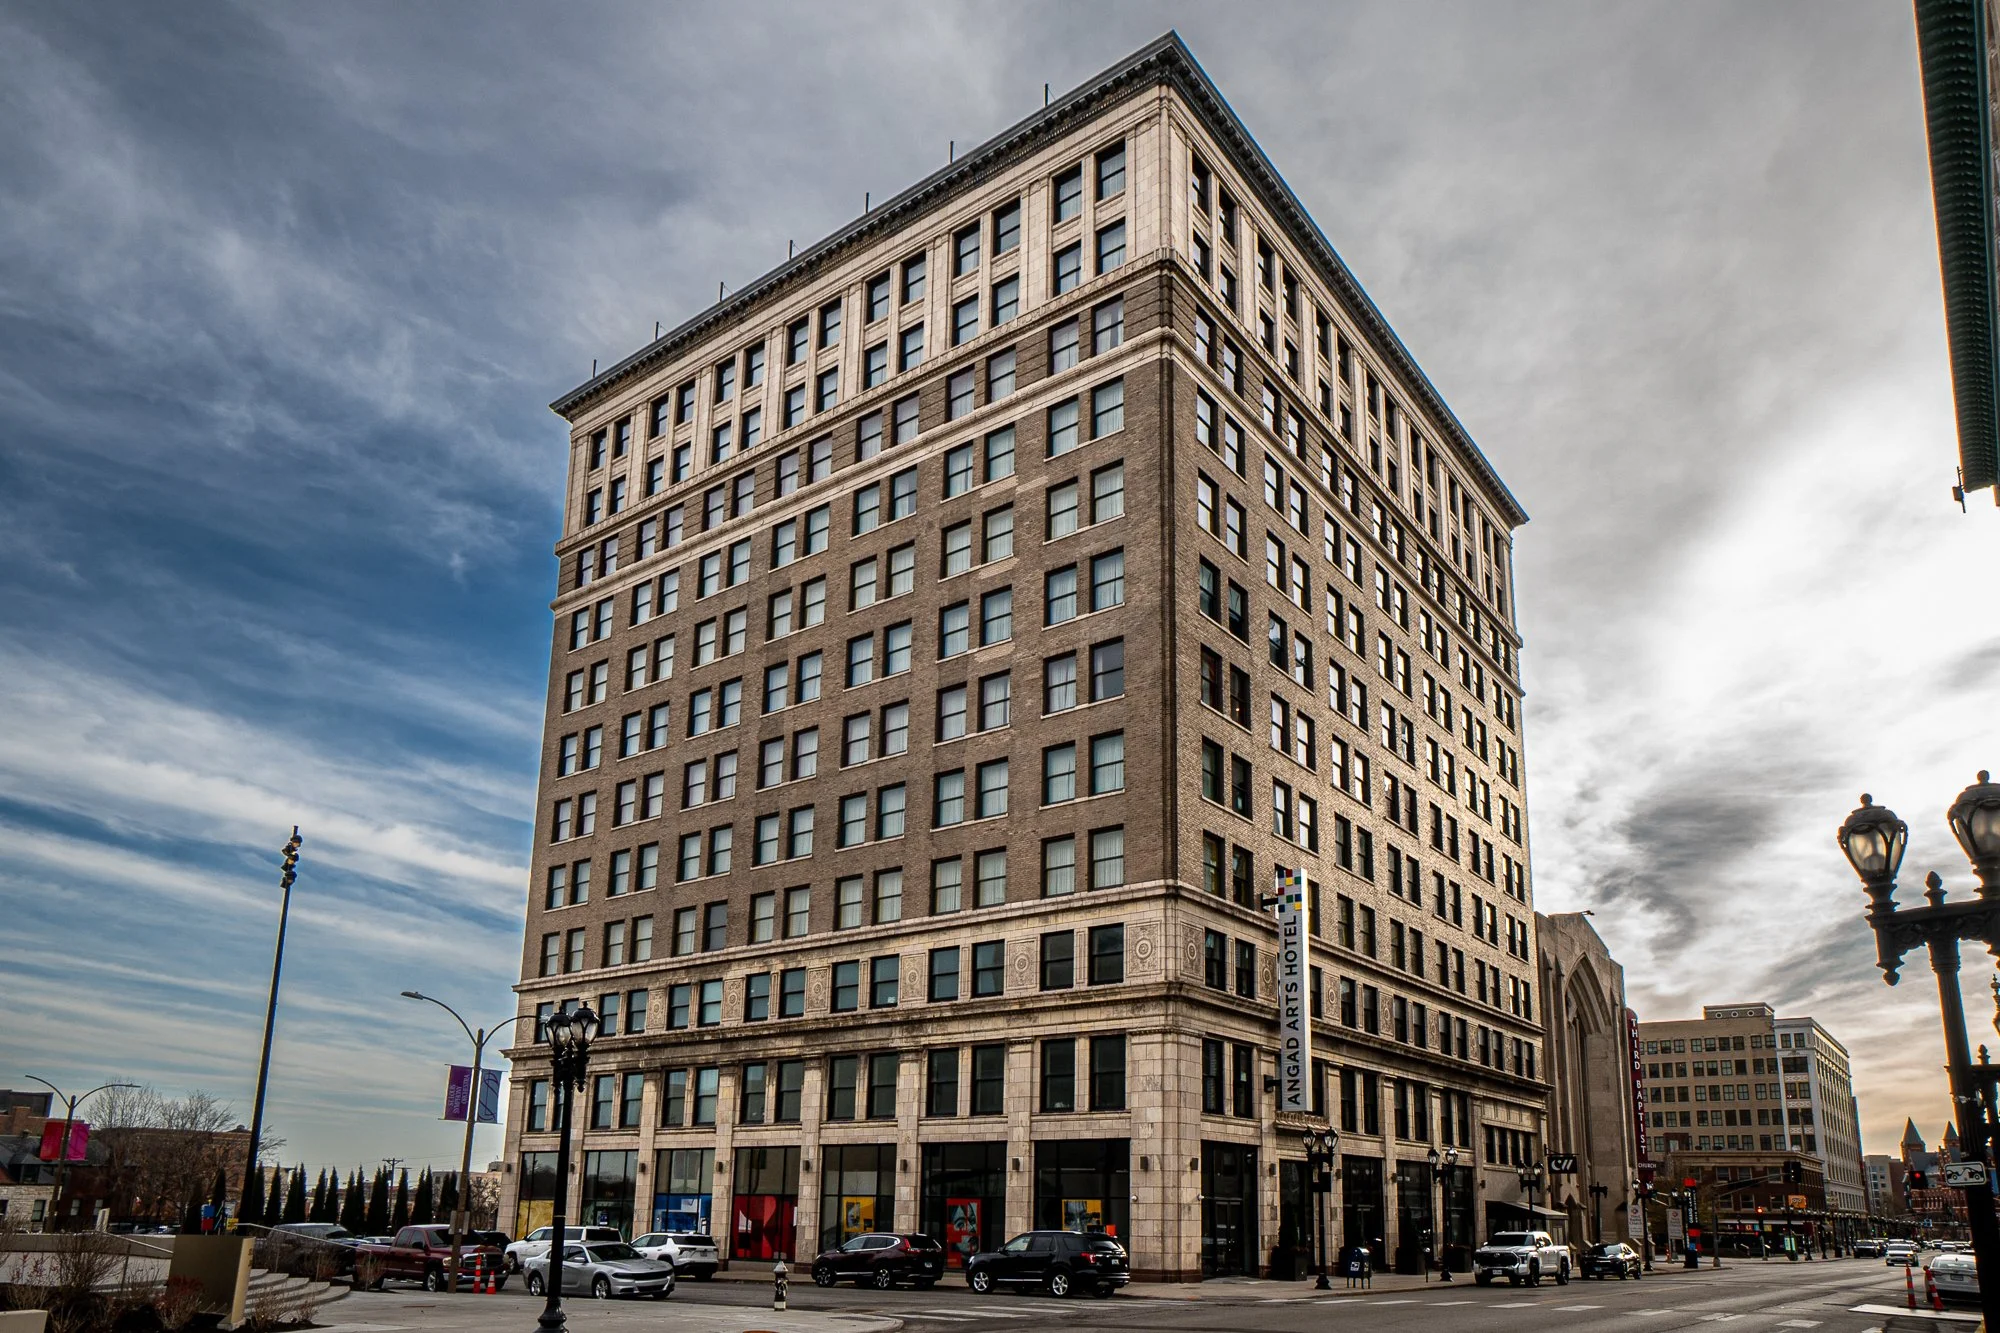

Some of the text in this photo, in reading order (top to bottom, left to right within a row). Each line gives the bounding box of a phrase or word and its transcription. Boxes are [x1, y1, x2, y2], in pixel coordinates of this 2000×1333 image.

[1283, 915, 1301, 1106] ANGAD ARTS HOTEL
[1631, 1018, 1647, 1155] THIRD BAPTIST
